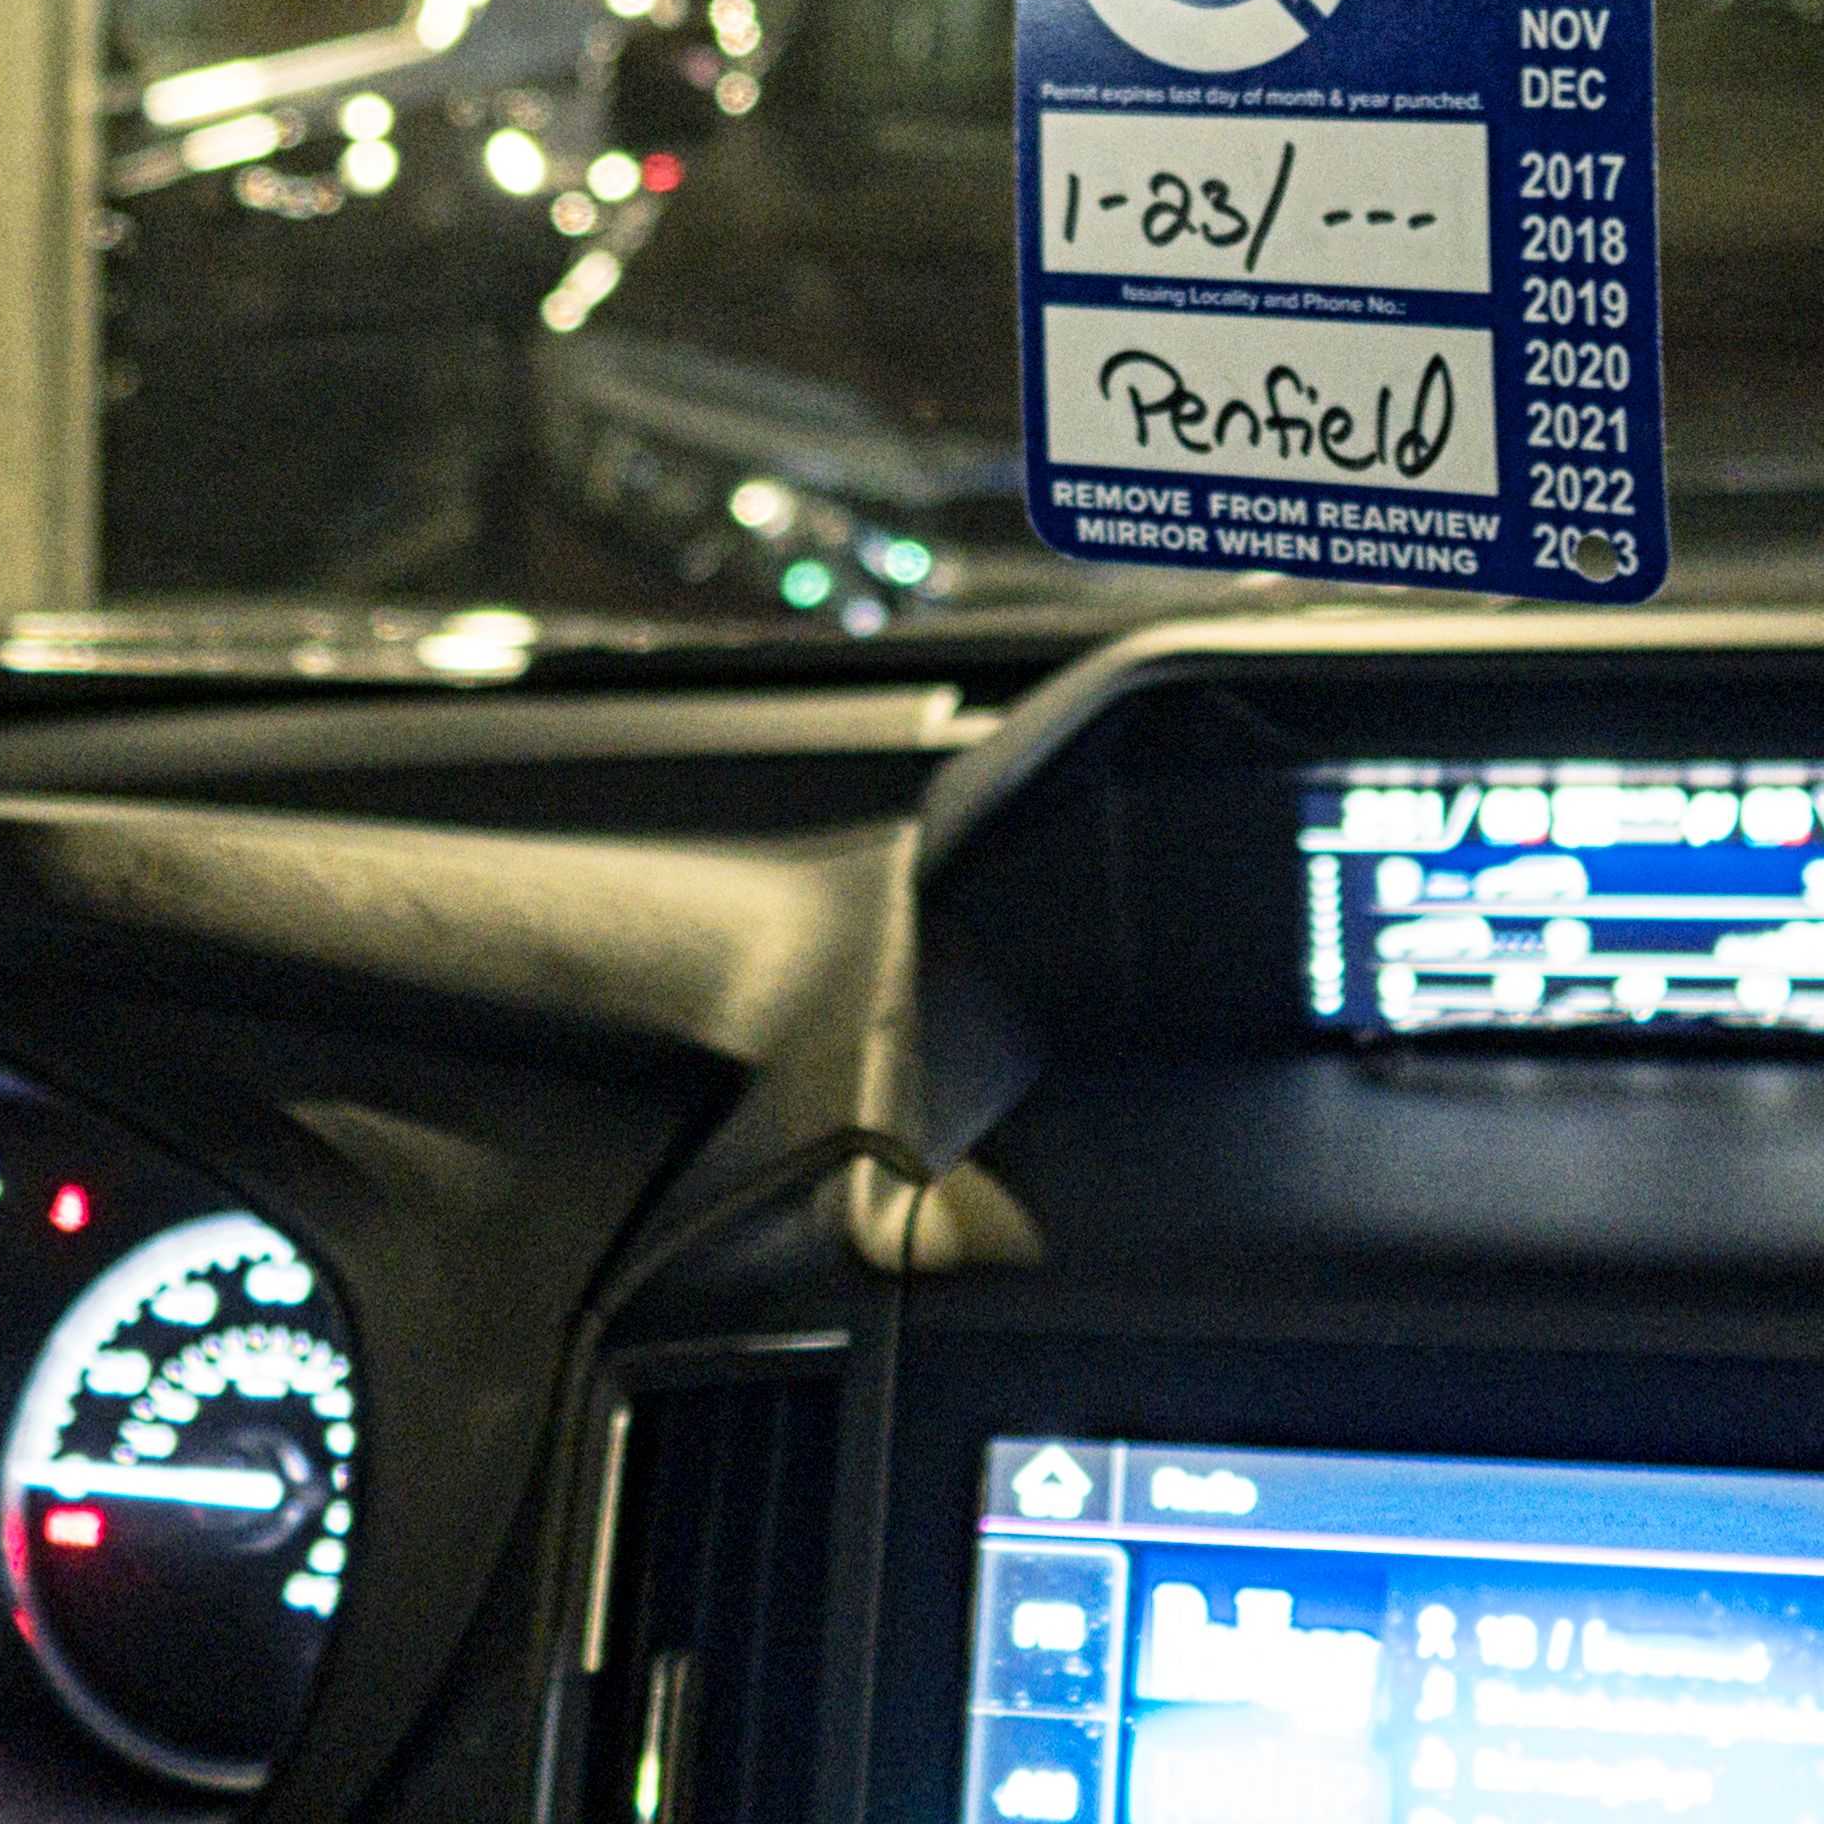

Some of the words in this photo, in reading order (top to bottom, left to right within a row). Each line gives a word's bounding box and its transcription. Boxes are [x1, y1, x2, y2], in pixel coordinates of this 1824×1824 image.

[1520, 9, 1610, 50] NOV
[1041, 81, 1097, 100] Permit
[1101, 84, 1166, 105] expires
[1169, 84, 1202, 104] last
[1206, 86, 1239, 108] day
[1242, 86, 1264, 105] of
[1266, 88, 1325, 107] month
[1328, 89, 1344, 108] &
[1348, 92, 1388, 111] year
[1520, 67, 1606, 109] DEC
[1519, 152, 1626, 202] 2017
[1521, 215, 1628, 265] 2018
[1121, 284, 1186, 307] Issuing
[1188, 286, 1259, 311] Locality
[1263, 291, 1299, 308] and
[1303, 292, 1364, 313] Phone
[1522, 277, 1630, 328] 2019
[1524, 340, 1631, 391] 2020
[1100, 349, 1455, 480] Penfield
[1526, 403, 1630, 453] 2021
[1052, 481, 1191, 517] REMOVE
[1208, 490, 1310, 525] FROM
[1318, 500, 1501, 542] REARVIEW
[1530, 465, 1635, 515] 2022
[1075, 517, 1209, 554] MIRROR
[1216, 527, 1321, 562] WHEN
[1330, 537, 1478, 574] DRIVING
[1533, 522, 1640, 578] 203
